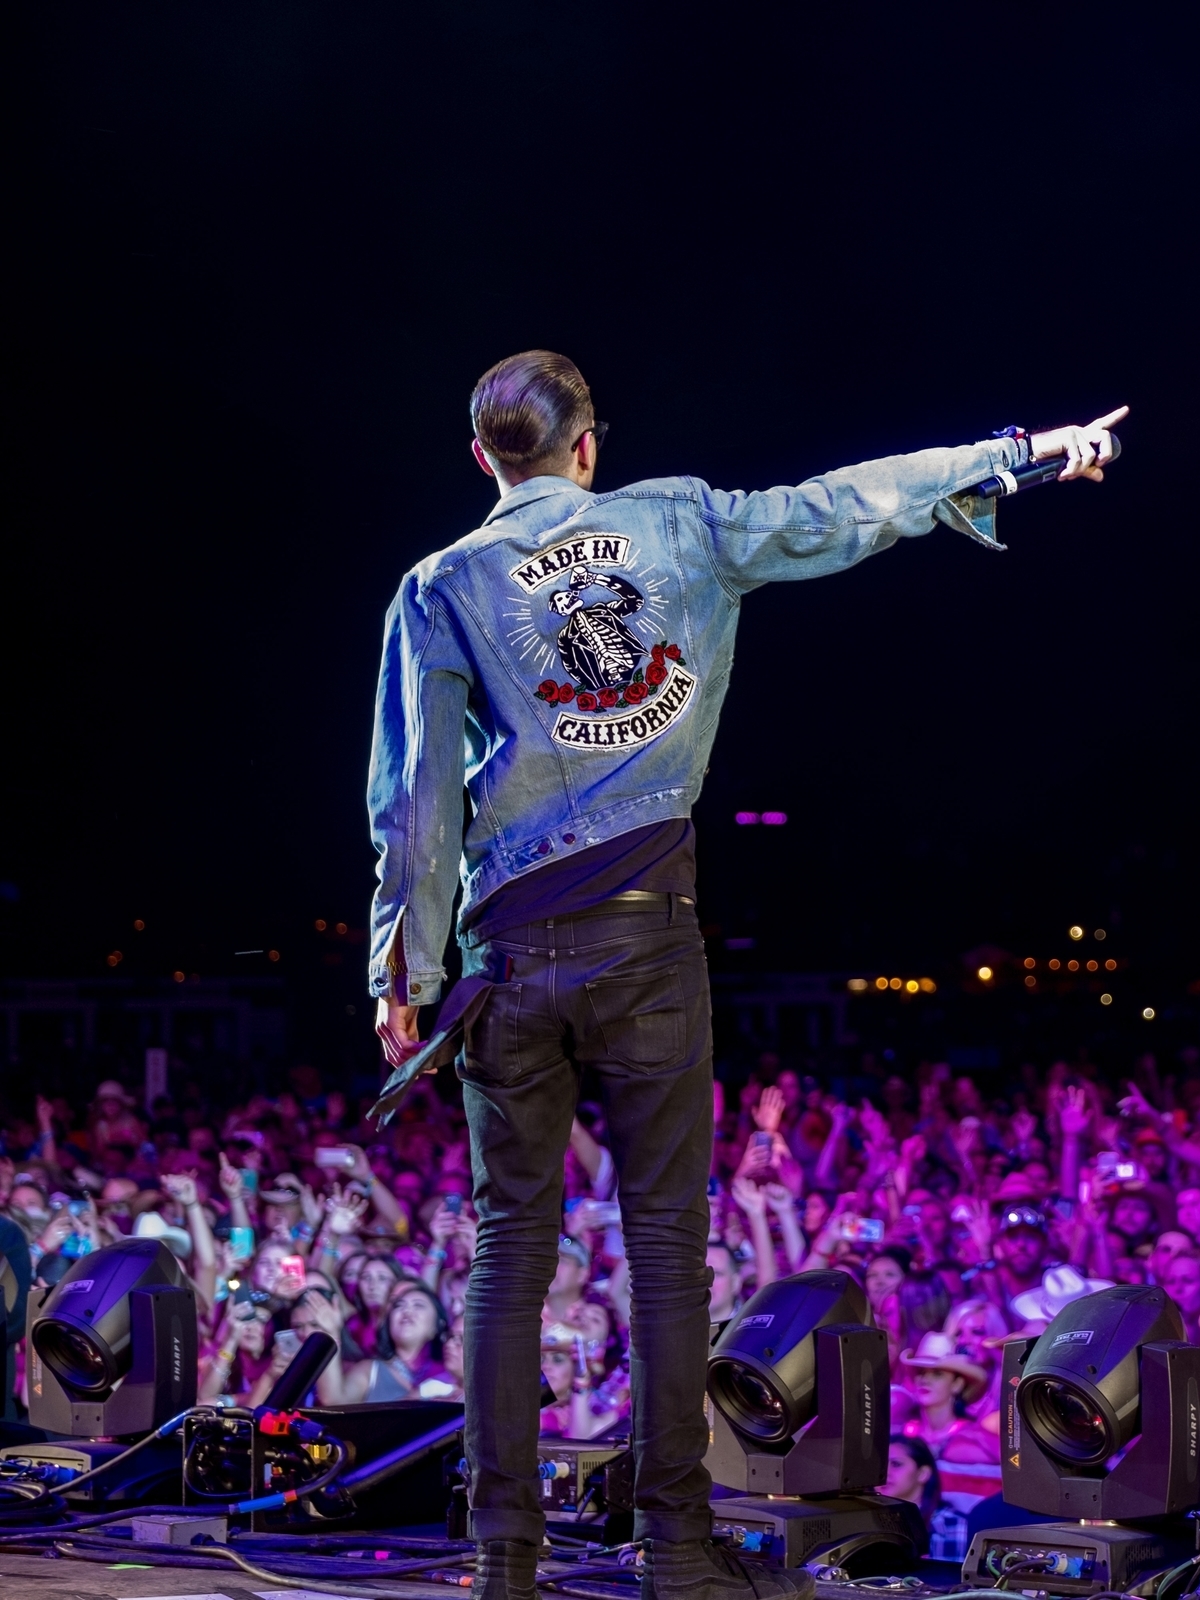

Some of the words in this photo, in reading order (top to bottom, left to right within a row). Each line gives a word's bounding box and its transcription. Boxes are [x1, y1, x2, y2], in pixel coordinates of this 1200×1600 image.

[518, 541, 587, 586] MADE
[593, 539, 620, 560] IN
[558, 675, 691, 745] CALIFORNIA
